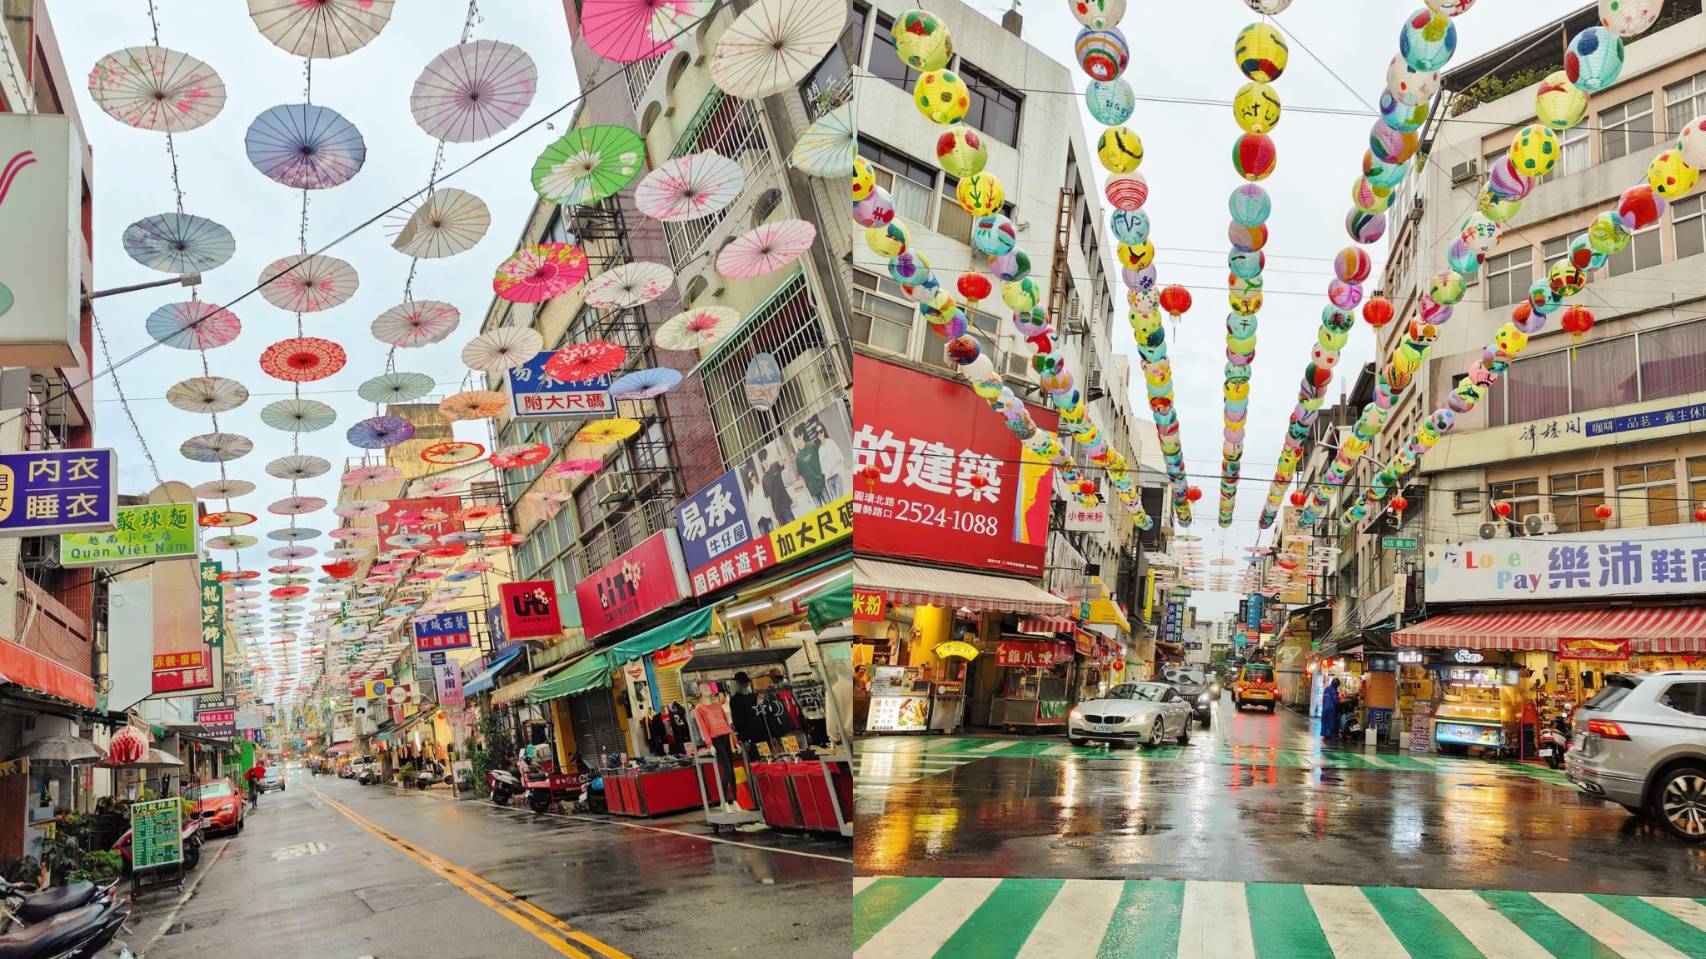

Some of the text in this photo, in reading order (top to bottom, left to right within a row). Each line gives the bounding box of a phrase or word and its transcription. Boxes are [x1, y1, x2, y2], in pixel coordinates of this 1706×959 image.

[523, 393, 606, 412] 附大尺碼
[28, 456, 99, 482] 內衣
[853, 424, 1004, 504] 的建築
[26, 492, 99, 519] 睡衣
[682, 483, 737, 542] 易承
[895, 499, 999, 537] 2524-1088
[117, 507, 188, 532] 酸辣麵
[155, 543, 188, 553] Nam
[709, 526, 748, 553] 牛仔屋
[693, 544, 768, 595] 國民旅遊卡
[1466, 550, 1521, 568] Loe
[1497, 571, 1542, 593] Pay
[853, 593, 881, 616] 米粉
